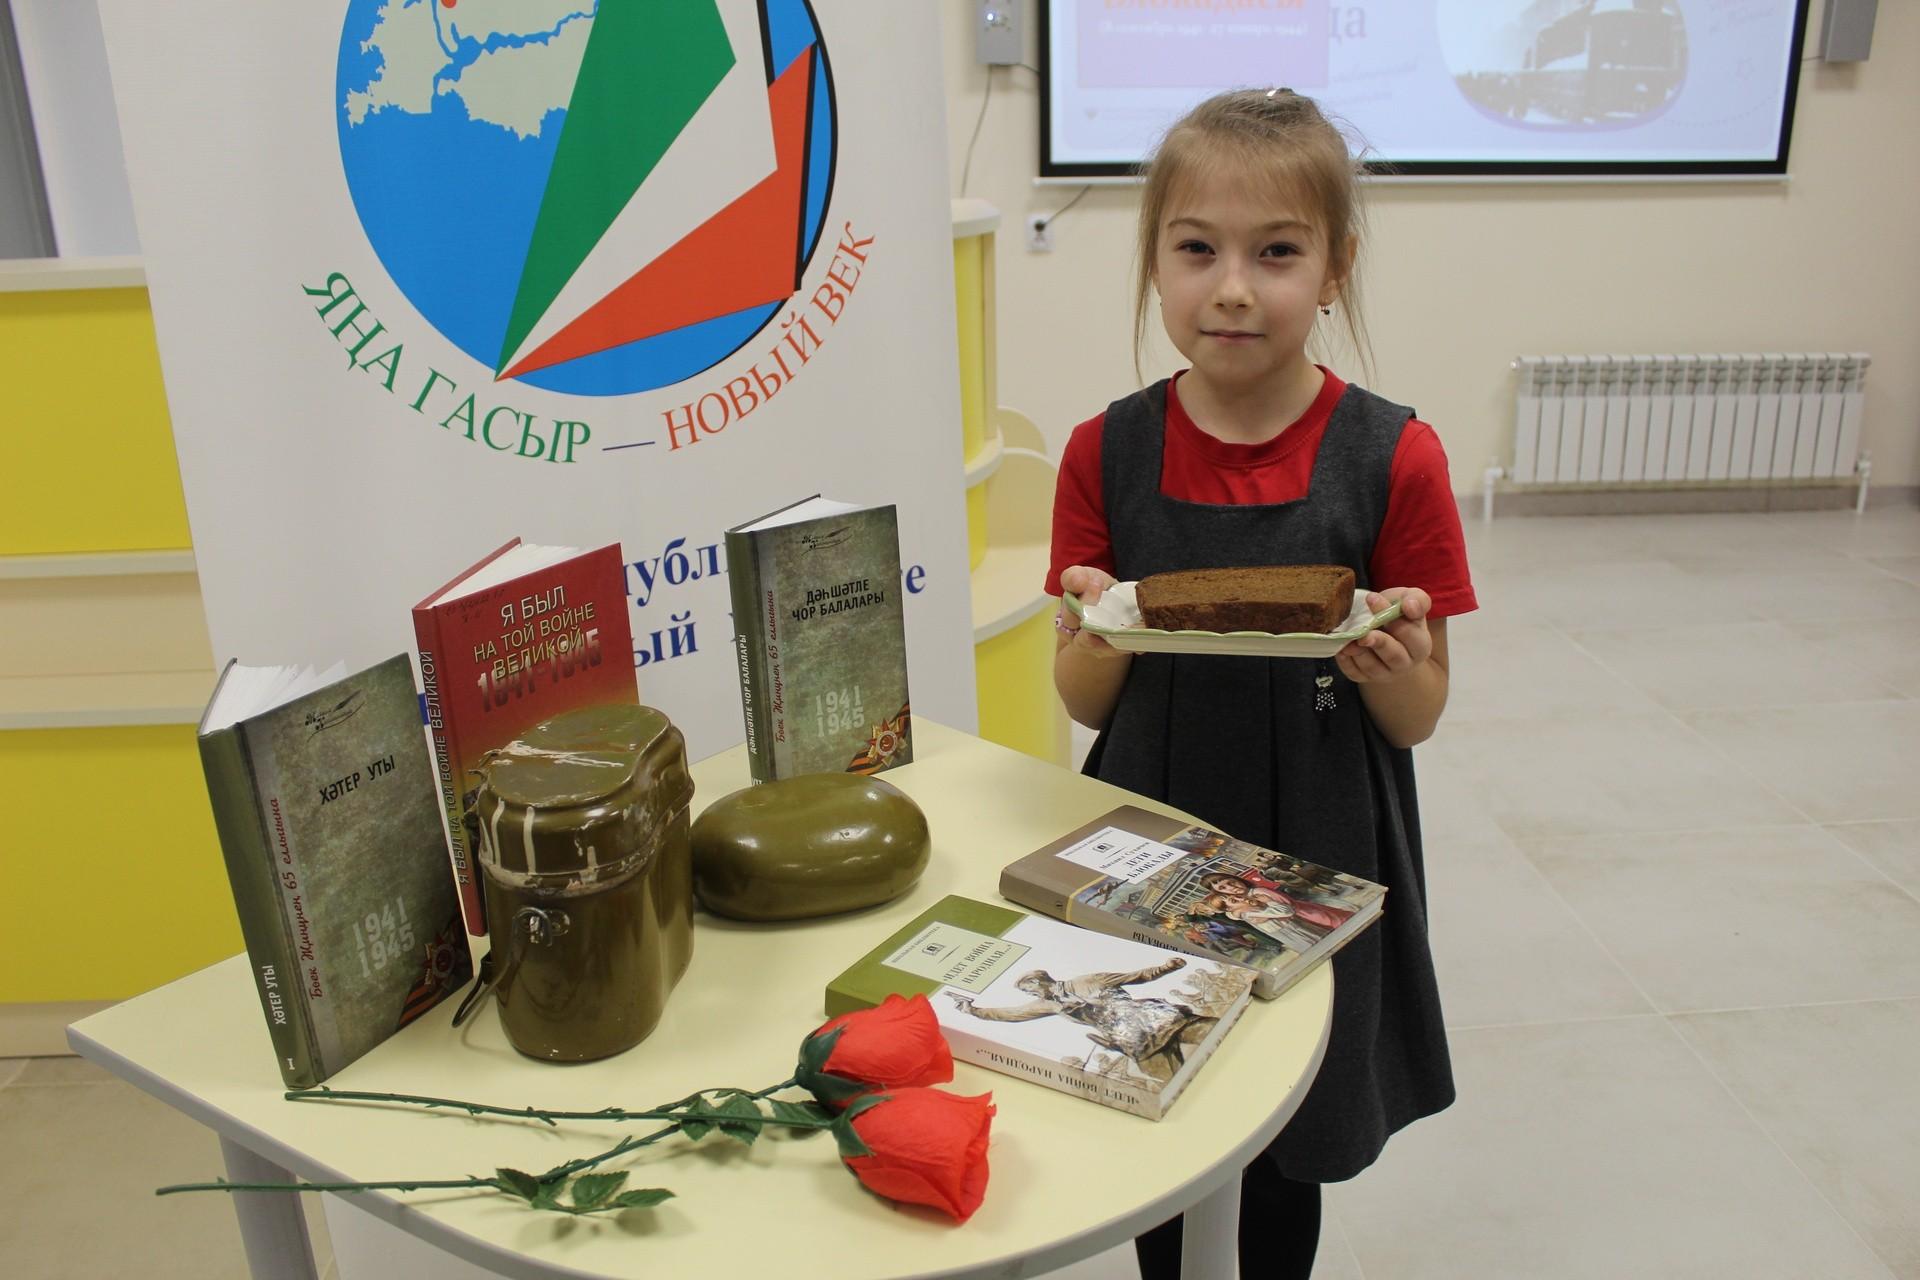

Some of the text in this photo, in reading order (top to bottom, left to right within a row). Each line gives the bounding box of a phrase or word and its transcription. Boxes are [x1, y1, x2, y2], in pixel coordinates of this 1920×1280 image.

[302, 271, 404, 393] ЯҢА
[408, 367, 591, 463] ГАСЫР
[661, 311, 824, 451] НОВЫЙ
[812, 221, 875, 325] ВЕК
[501, 604, 514, 627] Я
[521, 586, 565, 620] БЫЛ
[792, 591, 884, 621] ЧОР БАЛАЛАРЫ
[474, 640, 497, 663] НА
[501, 622, 535, 651] ТОЙ
[540, 602, 595, 637] ВОЙНЕ
[493, 625, 584, 679] ВЕЛИКОЙ
[739, 634, 750, 686] БАЛАЛАРЫ
[768, 645, 778, 659] 65
[420, 651, 442, 728] ВЕЛИКОЙ
[743, 687, 752, 706] ЧОР
[816, 685, 861, 715] 1941
[817, 706, 864, 737] 1945
[319, 755, 395, 805] ХӘТЕР УТЫ
[451, 815, 461, 832] НА
[455, 835, 467, 869] БЫЛ
[1124, 852, 1151, 868] ДЕТИ
[1127, 851, 1174, 877] БЛОКАДЫ
[284, 871, 297, 889] 65
[459, 874, 469, 884] Я
[352, 895, 408, 948] 1941
[356, 923, 415, 978] 1945
[965, 940, 995, 963] ВОЙНА
[262, 965, 286, 1025] ХӘТЕР УТЫ
[1058, 1075, 1097, 1093] ВОЙНА
